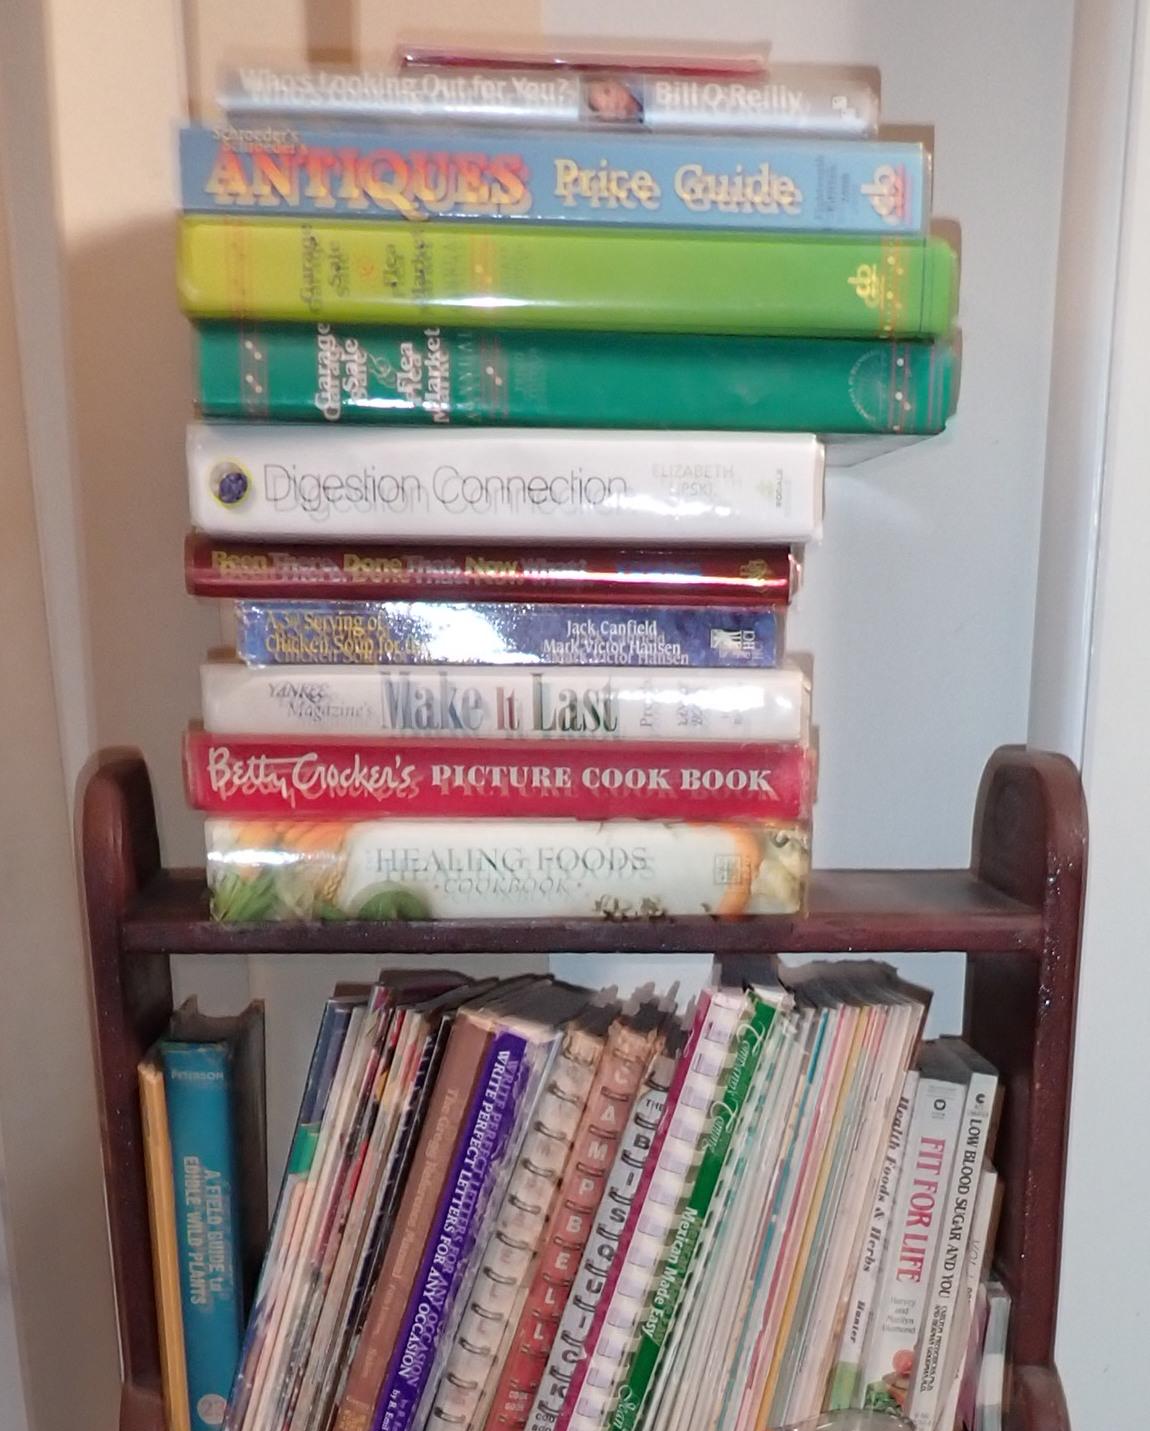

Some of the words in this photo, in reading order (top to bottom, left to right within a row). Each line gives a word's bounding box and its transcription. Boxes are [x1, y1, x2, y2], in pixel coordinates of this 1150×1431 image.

[317, 70, 418, 108] Looking
[421, 74, 469, 101] Out
[471, 76, 508, 101] for
[511, 76, 569, 103] You?
[655, 81, 698, 106] Bill
[205, 145, 530, 218] ANTIQUES
[554, 158, 660, 206] Price
[674, 161, 800, 210] Guide
[314, 322, 341, 419] Garage
[343, 337, 367, 400] Sale
[397, 343, 421, 401] Flea
[425, 327, 449, 422] Market
[263, 463, 421, 512] Digestion
[432, 464, 628, 507] Connection
[212, 550, 271, 572] Been
[342, 554, 403, 574] Done
[265, 610, 277, 630] A
[303, 612, 364, 638] Serving
[567, 619, 597, 636] Jack
[600, 620, 658, 637] Canfield
[332, 634, 376, 659] Soup
[544, 639, 580, 656] Mark
[583, 639, 624, 656] Victor
[629, 639, 681, 657] Hansen
[379, 670, 484, 732] Make
[496, 686, 520, 732] It
[531, 672, 618, 733] Last
[206, 746, 296, 803] Betty
[292, 752, 418, 799] Crocker's
[431, 763, 572, 793] PICTURE
[581, 766, 673, 793] COOK
[680, 768, 777, 795] BOOK
[375, 847, 525, 873] HEALING
[538, 846, 649, 873] FOODS
[442, 877, 571, 896] COOKBOOK
[485, 1050, 510, 1099] WRITE
[645, 1098, 665, 1112] THE
[888, 1095, 910, 1151] Health
[463, 1100, 493, 1174] PERFECT
[916, 1135, 947, 1176] FIT
[965, 1118, 983, 1150] LOW
[184, 1156, 200, 1204] EDIBLE
[204, 1170, 221, 1181] A
[877, 1154, 898, 1203] Foods
[957, 1150, 977, 1196] BLOOD
[205, 1188, 223, 1224] FIELD
[443, 1169, 473, 1234] LETTERS
[873, 1206, 886, 1221] &
[905, 1178, 939, 1228] FOR
[948, 1198, 969, 1242] SUGAR
[186, 1212, 202, 1248] WILD
[432, 1234, 453, 1264] FOR
[668, 1205, 699, 1265] Mexican
[861, 1225, 882, 1272] Herbs
[207, 1231, 225, 1273] GUIDE
[895, 1232, 929, 1284] LIFE
[943, 1243, 959, 1273] AND
[188, 1251, 206, 1305] PLANTS
[422, 1267, 444, 1299] ANY
[654, 1265, 679, 1306] Made
[939, 1274, 954, 1298] YOU
[398, 1302, 430, 1377] OCCASION
[641, 1305, 665, 1338] Easy
[849, 1299, 866, 1344] Hunter
[535, 1411, 556, 1423] COO
